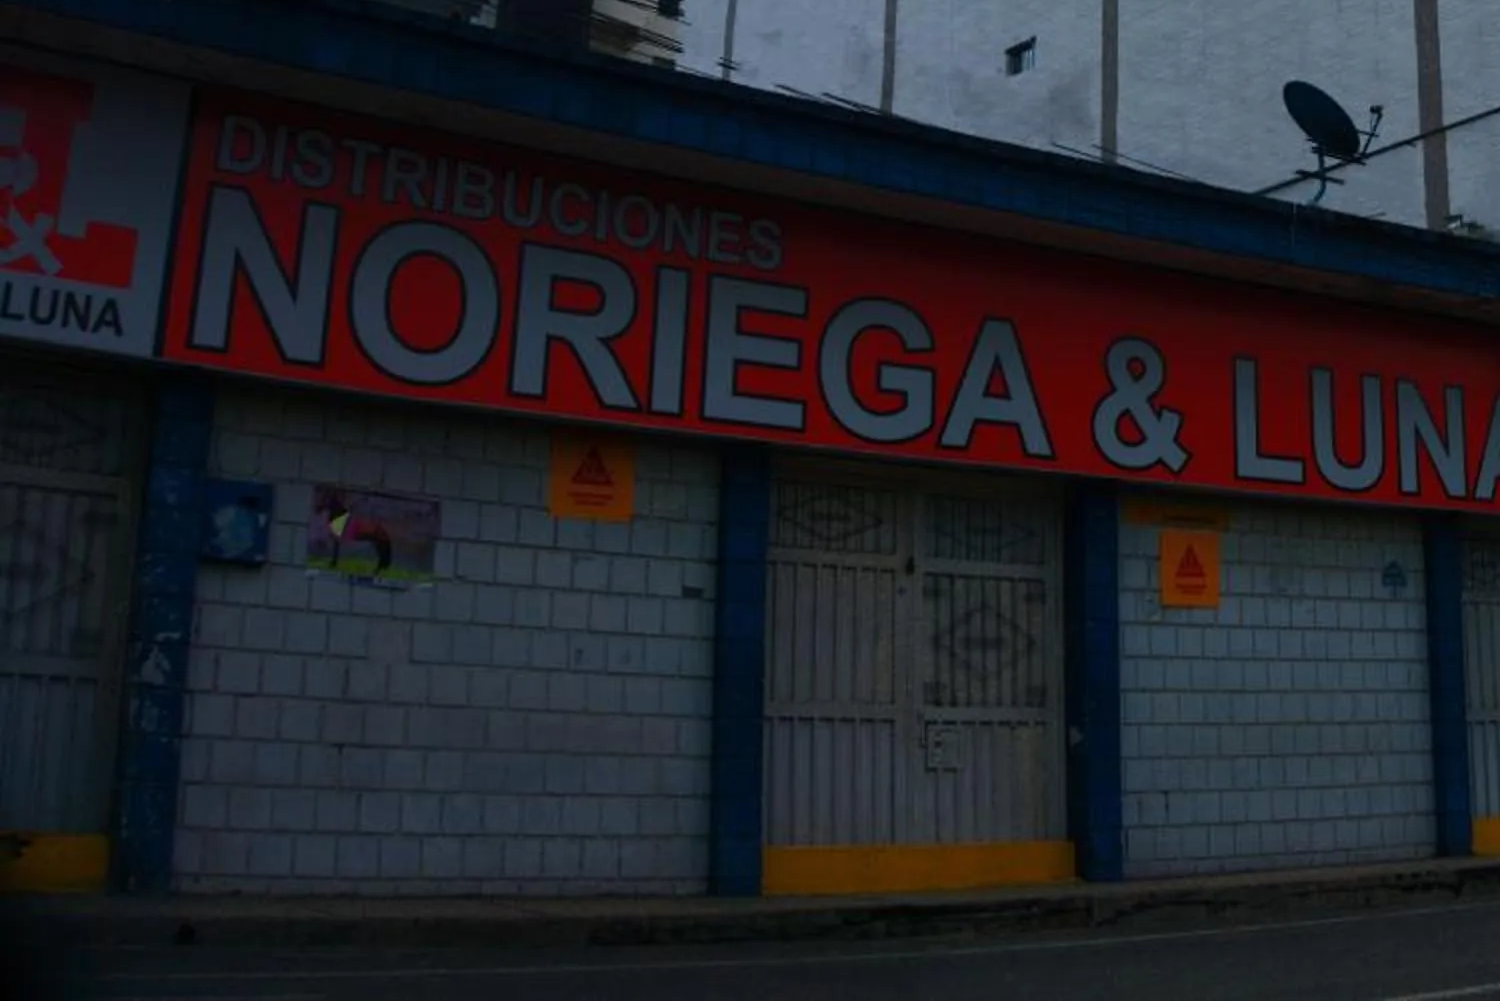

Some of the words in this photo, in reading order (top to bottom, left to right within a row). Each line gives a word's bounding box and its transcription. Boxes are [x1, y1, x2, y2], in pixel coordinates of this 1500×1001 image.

[216, 113, 783, 271] DISTRIBUCIONES
[1, 281, 123, 337] LUNA
[186, 180, 1057, 462] NORIEGA
[1091, 335, 1193, 475] &
